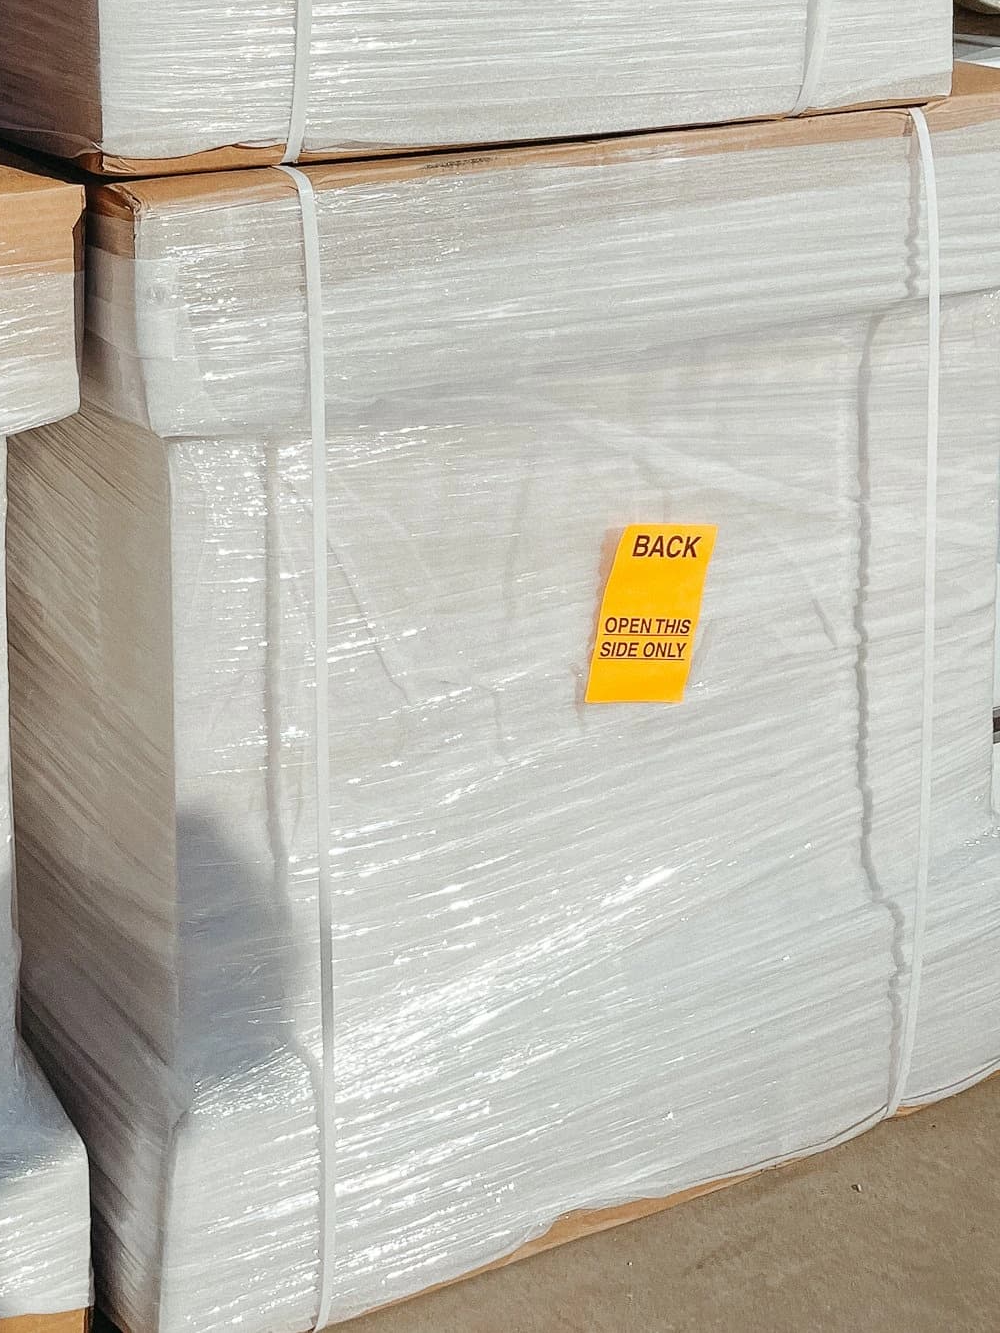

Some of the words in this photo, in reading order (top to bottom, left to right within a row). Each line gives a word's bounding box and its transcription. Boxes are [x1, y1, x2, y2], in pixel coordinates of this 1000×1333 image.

[631, 534, 702, 559] BACK
[604, 616, 652, 634] OPEN
[654, 618, 692, 634] THIS
[599, 641, 640, 658] SIDE
[642, 642, 688, 659] ONLY
